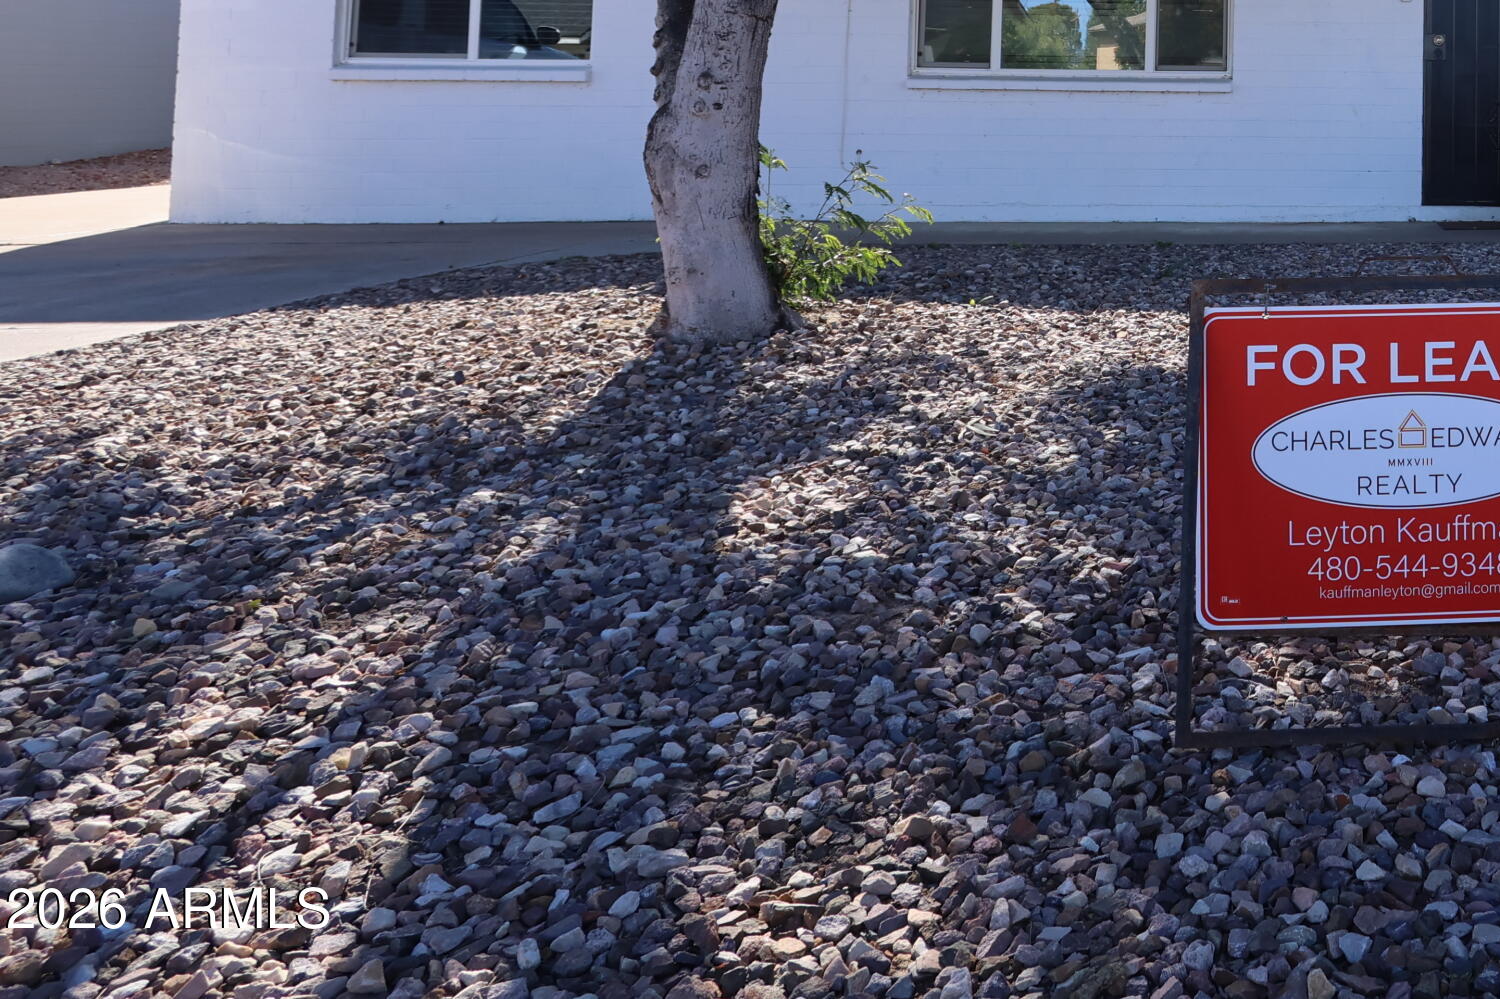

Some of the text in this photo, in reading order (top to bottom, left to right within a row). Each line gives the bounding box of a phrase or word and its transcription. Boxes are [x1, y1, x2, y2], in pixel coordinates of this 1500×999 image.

[1247, 343, 1367, 386] FOR
[1271, 429, 1395, 452] CHARLES
[1388, 458, 1433, 467] MMXVIII
[1357, 473, 1462, 496] REALTY
[1288, 520, 1385, 552] Leyton
